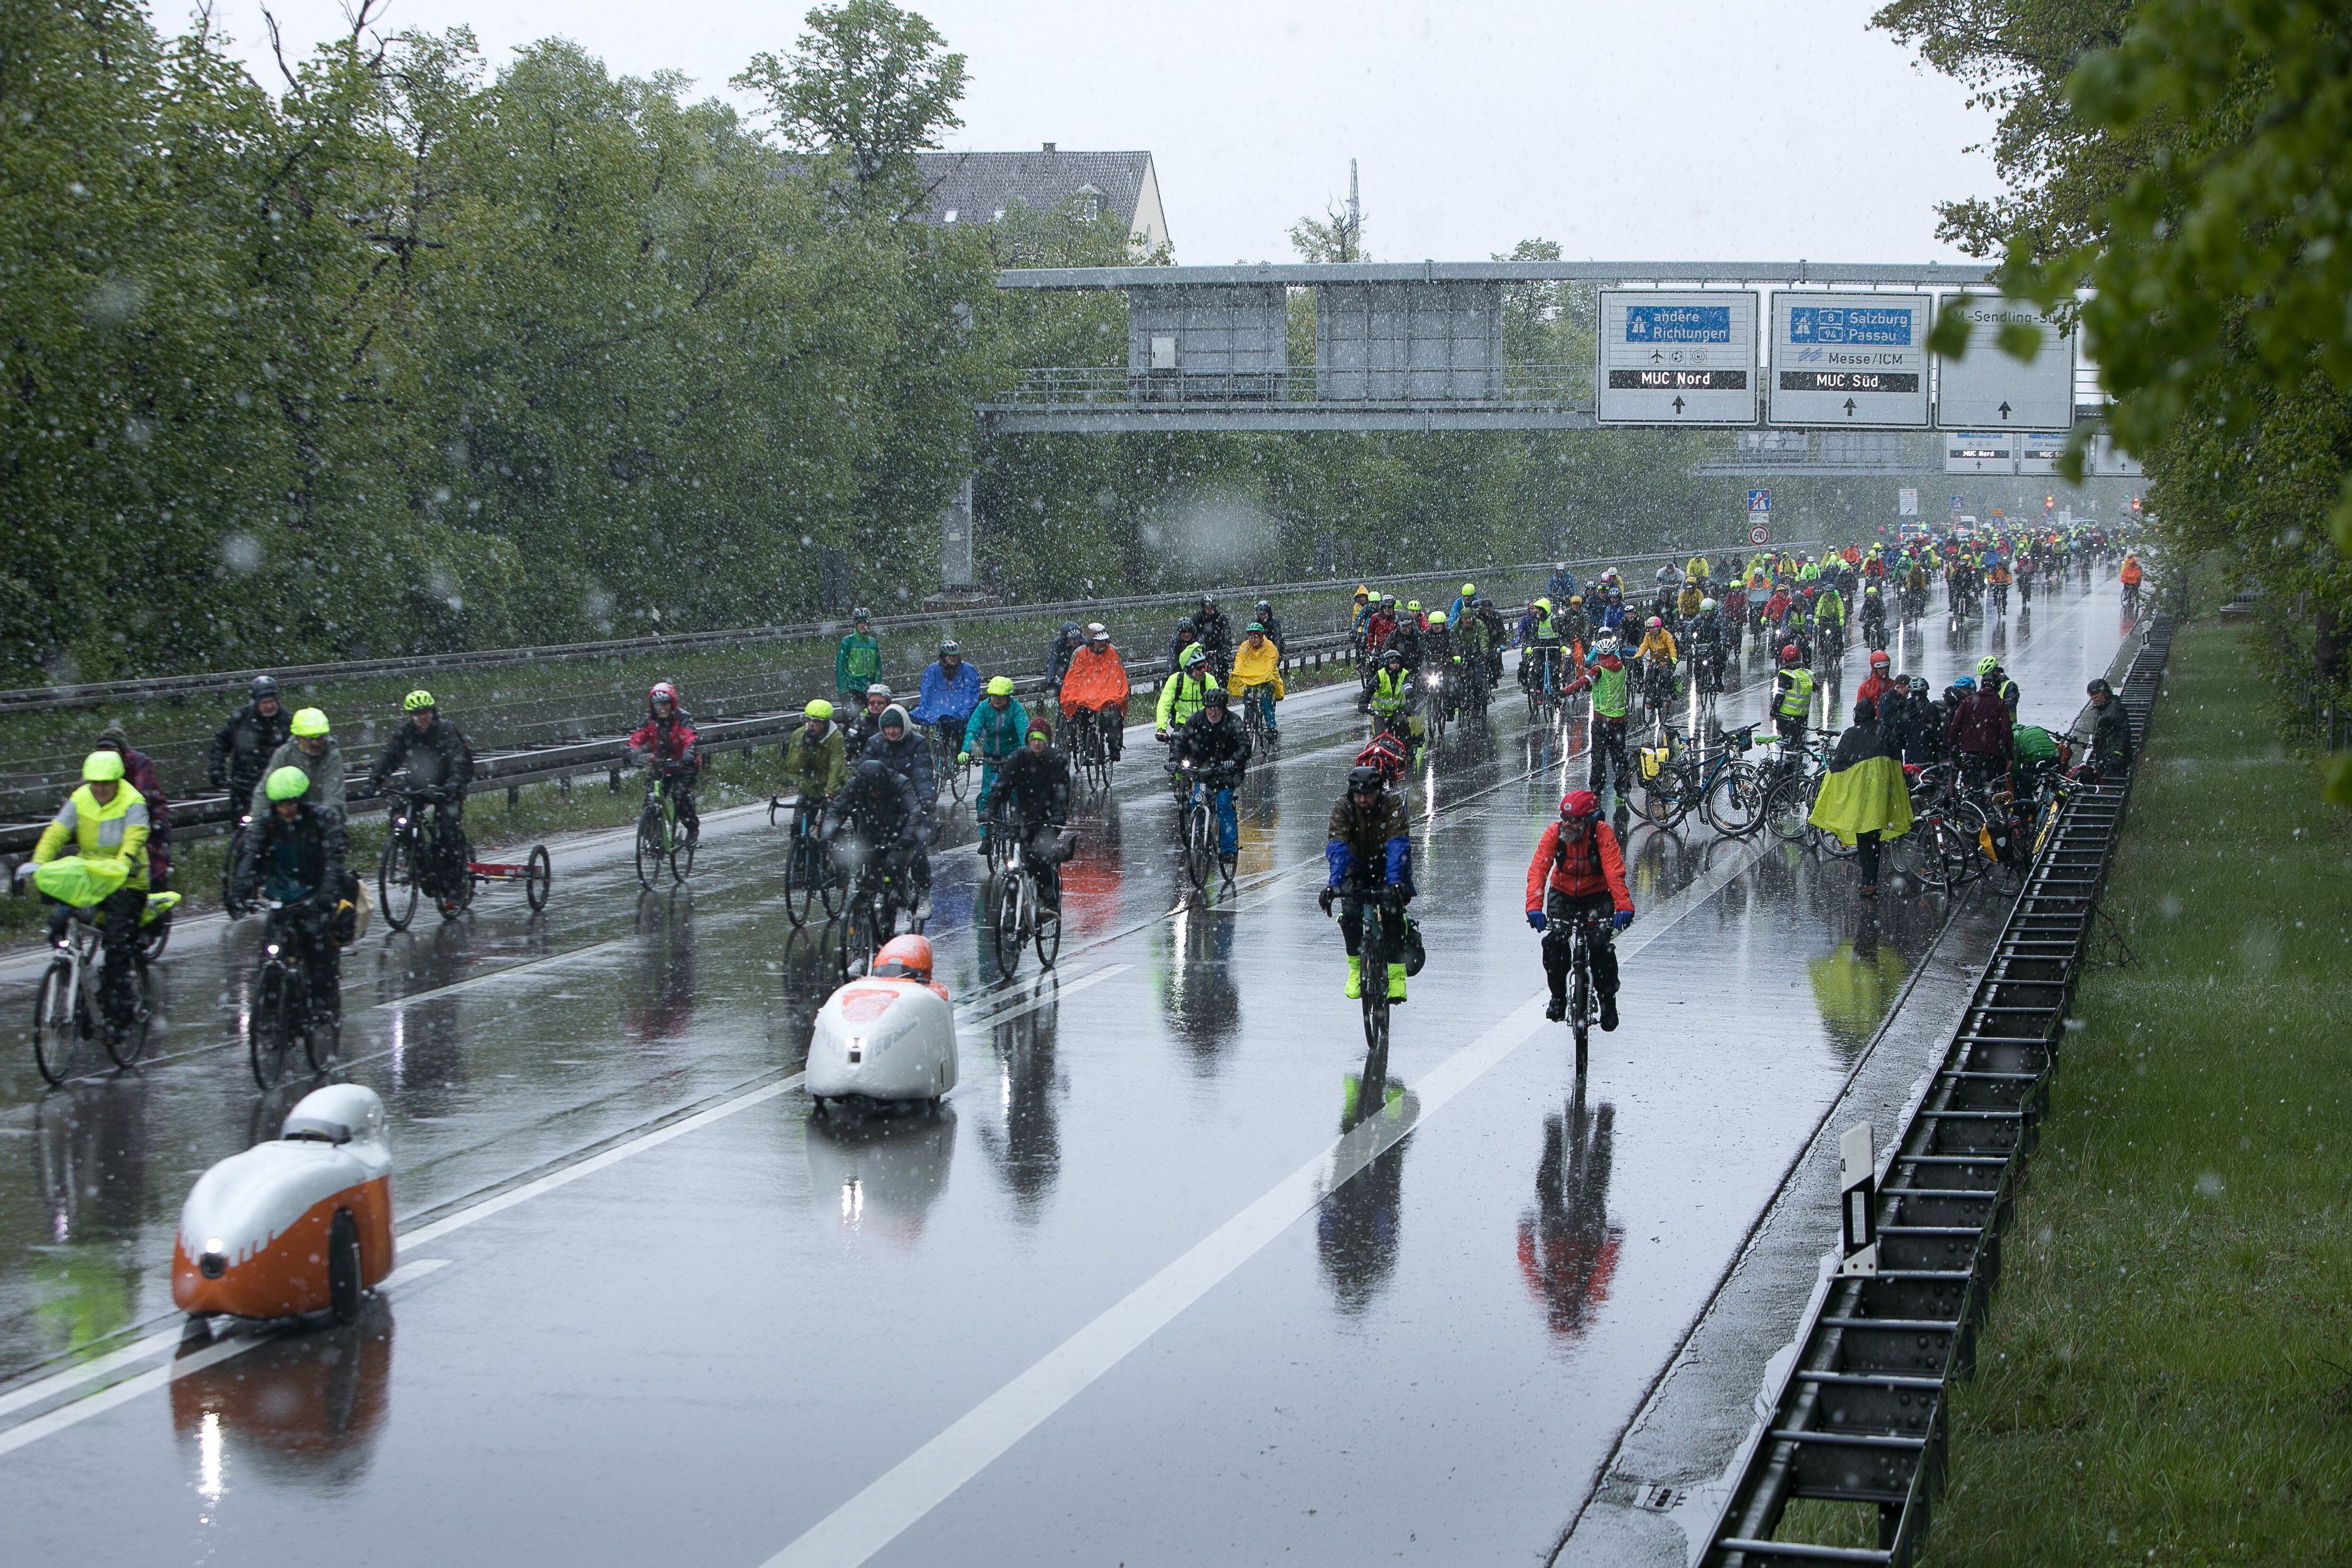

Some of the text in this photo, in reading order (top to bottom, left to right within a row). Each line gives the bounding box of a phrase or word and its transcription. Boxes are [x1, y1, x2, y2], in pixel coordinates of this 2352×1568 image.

[1653, 310, 1699, 322] andere
[1828, 312, 1907, 327] 8 Salzburg
[1653, 327, 1726, 342] Richtungen
[1825, 329, 1896, 341] 94 Passau
[1829, 352, 1903, 365] Messe/ICM
[1642, 372, 1710, 385] MUC Nord
[1816, 374, 1879, 387] MUC Süd
[1753, 530, 1765, 540] 60
